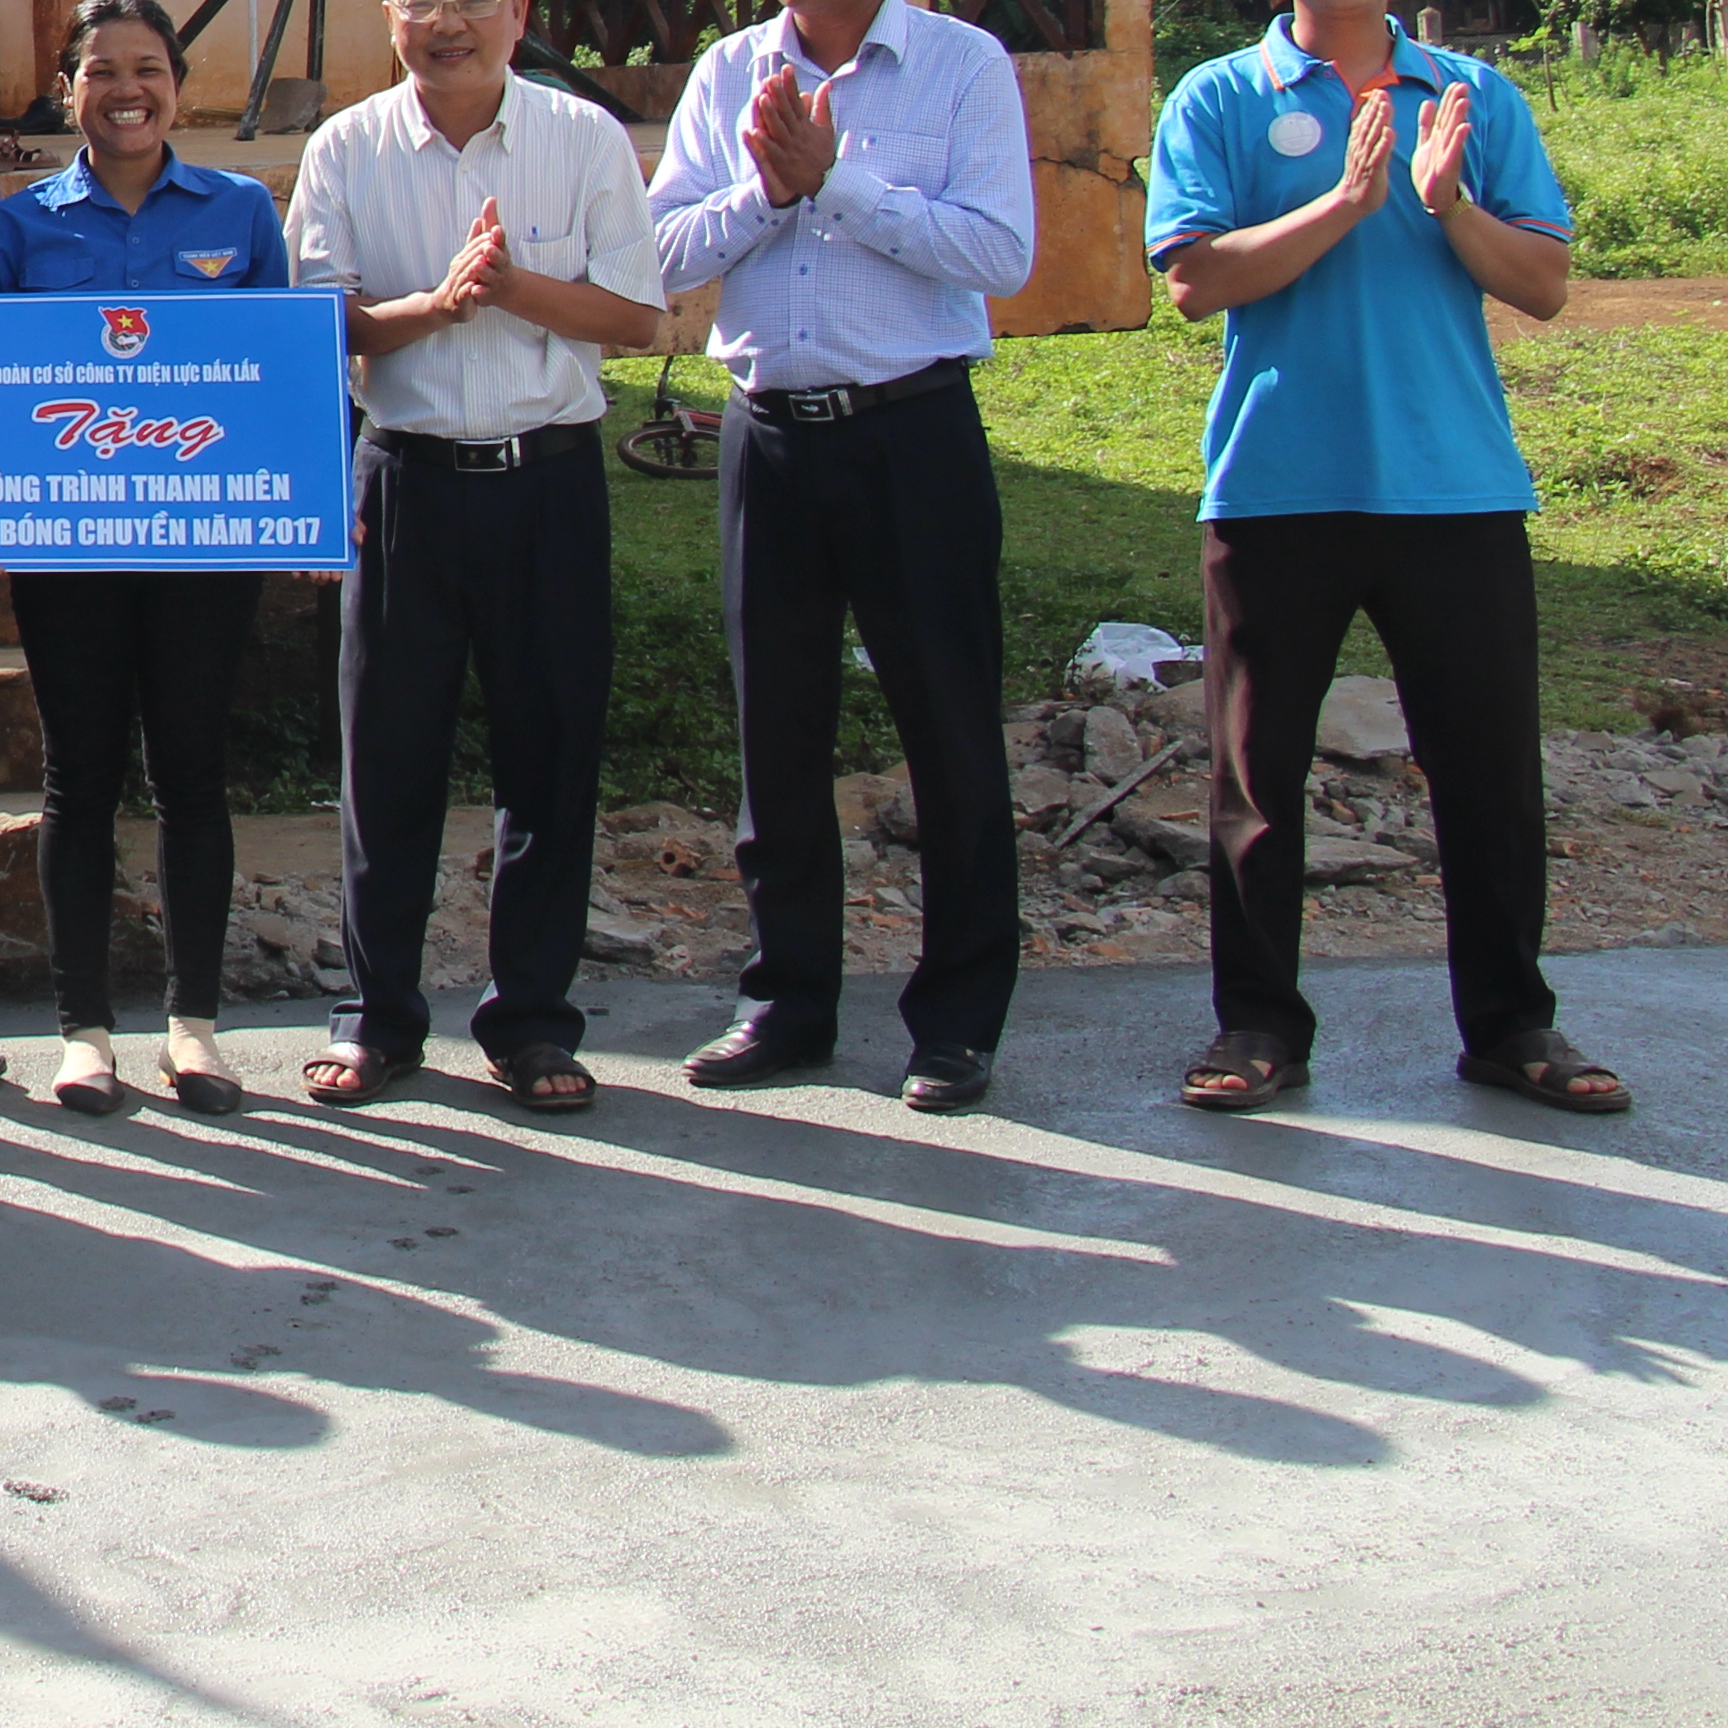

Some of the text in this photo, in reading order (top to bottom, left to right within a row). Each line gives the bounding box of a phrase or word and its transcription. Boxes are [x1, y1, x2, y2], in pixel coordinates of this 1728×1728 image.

[32, 363, 52, 384] CƠ
[55, 361, 74, 384] SỞ
[76, 362, 114, 383] CÔNG
[116, 365, 134, 383] TY
[137, 361, 171, 386] ĐIỆN
[173, 362, 200, 386] LỰC
[32, 398, 225, 462] Tặng
[46, 469, 126, 502] TRÌNH
[131, 474, 220, 502] THANH
[226, 468, 290, 501] NIÊN
[0, 512, 71, 545] BÓNG
[77, 510, 186, 545] CHUYỀN
[192, 513, 252, 544] NĂM
[258, 517, 320, 544] 2017
